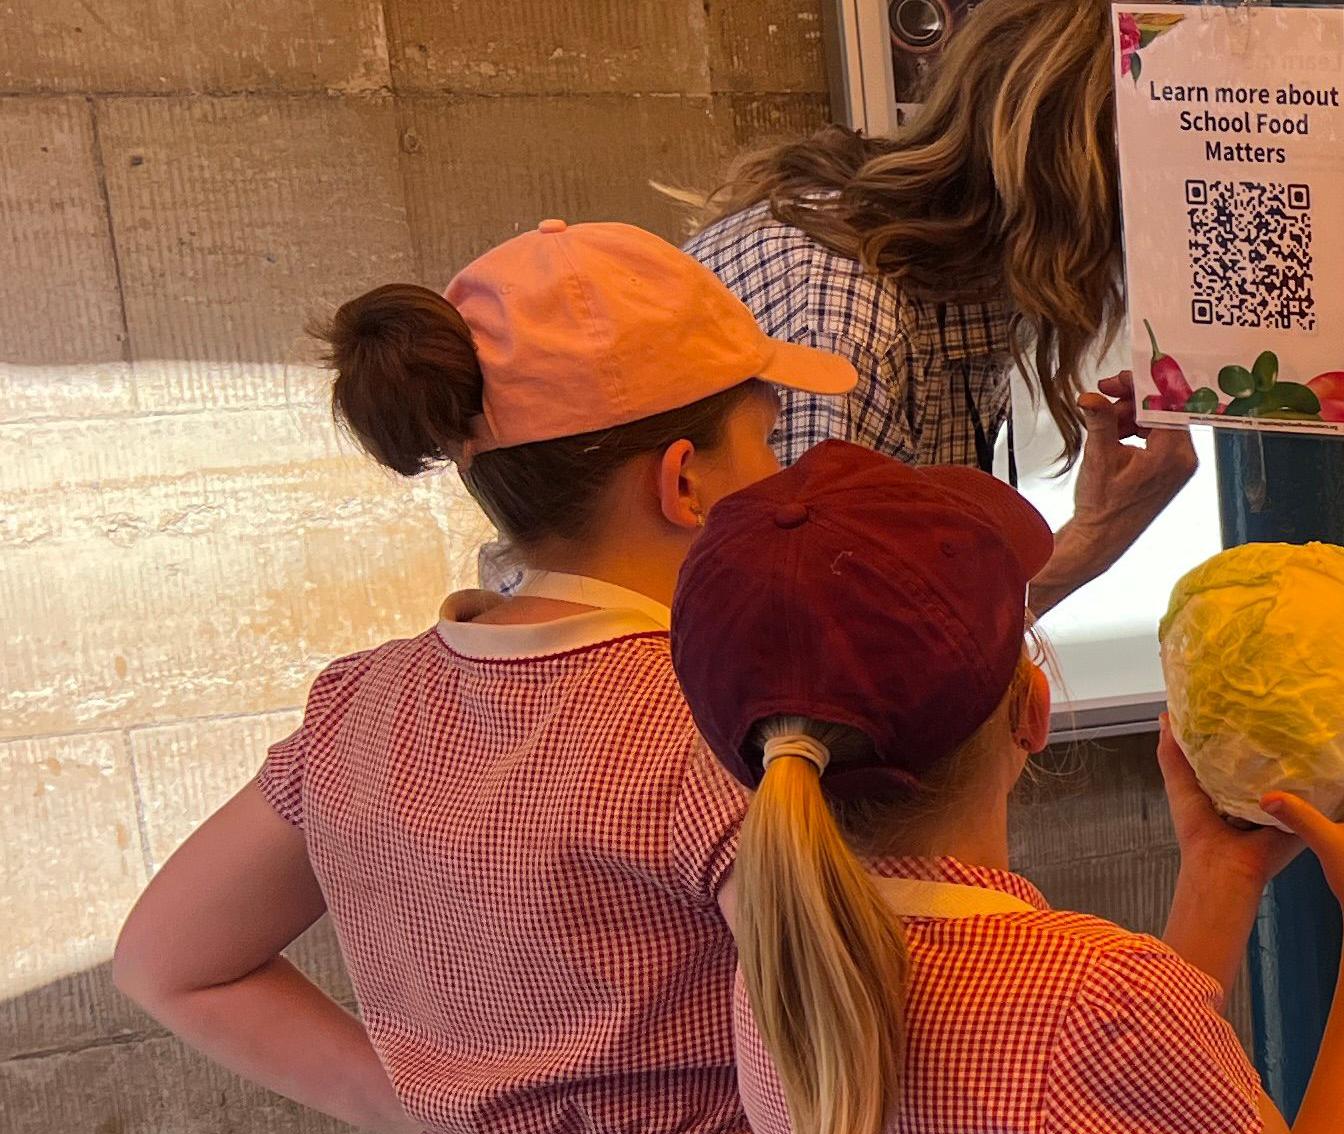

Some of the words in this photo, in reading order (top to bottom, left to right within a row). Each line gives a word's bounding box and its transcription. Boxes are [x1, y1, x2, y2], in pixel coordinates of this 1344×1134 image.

[1150, 80, 1208, 103] Learn
[1215, 87, 1270, 105] more
[1276, 84, 1339, 106] about
[1180, 110, 1250, 134] School
[1257, 113, 1309, 135] Food
[1205, 141, 1286, 164] Matters
